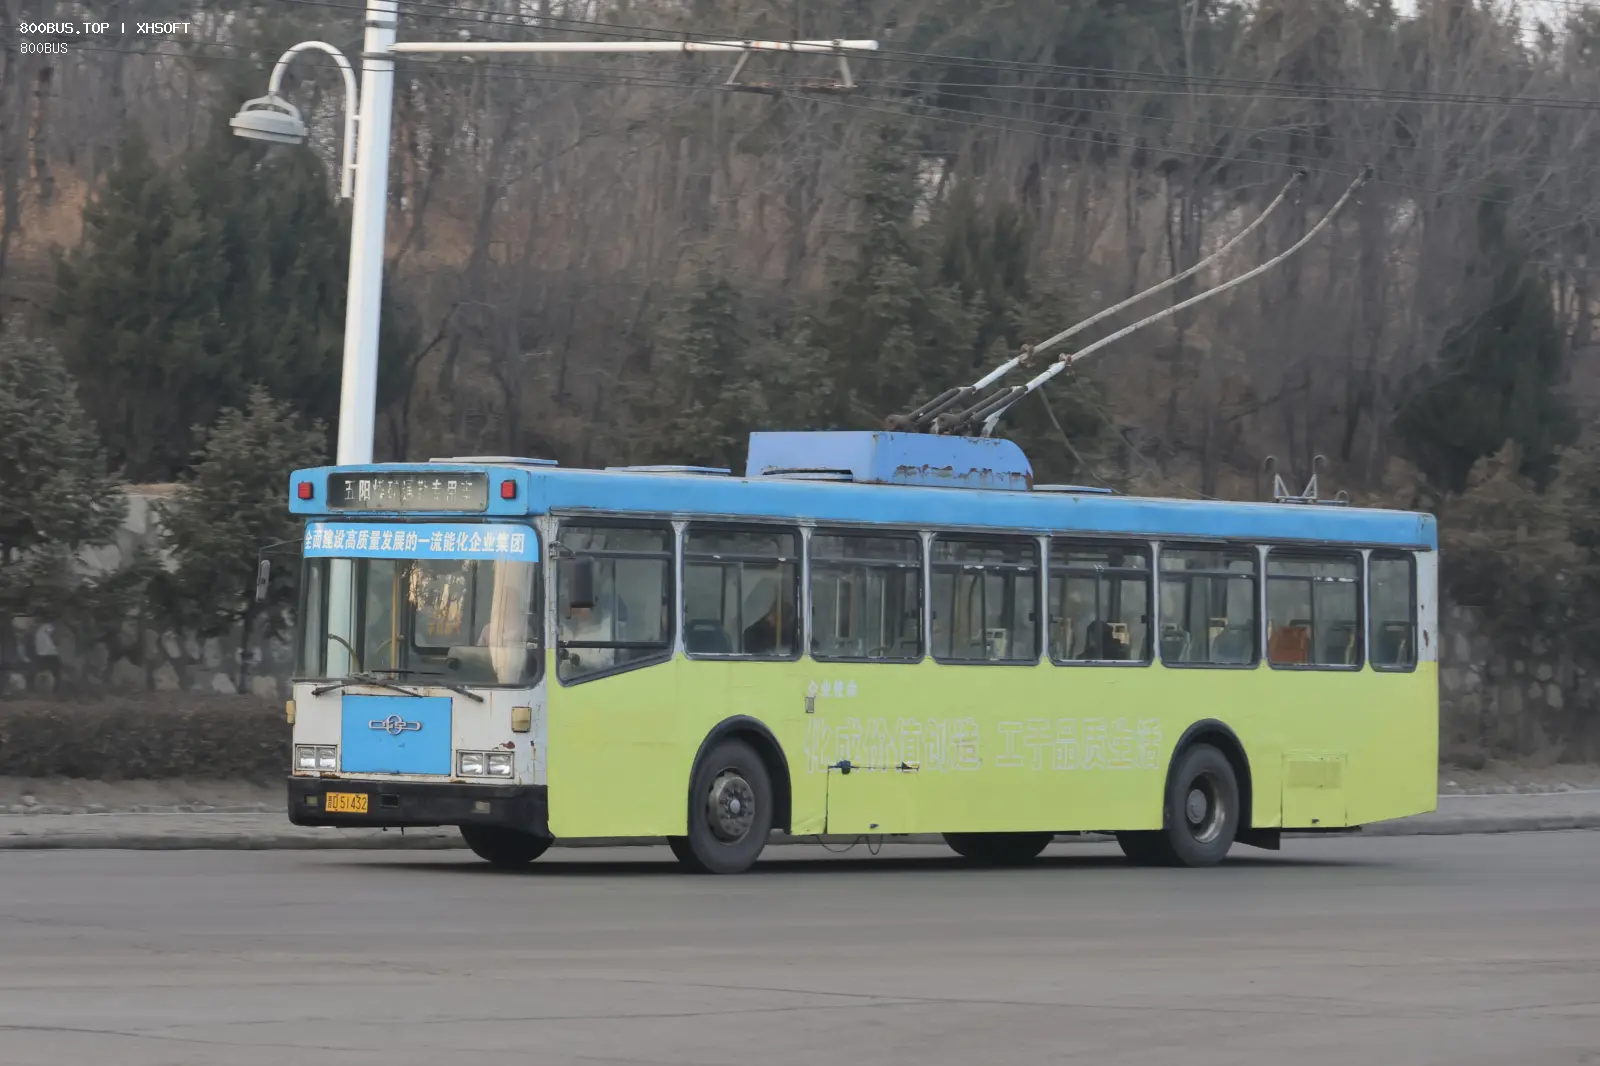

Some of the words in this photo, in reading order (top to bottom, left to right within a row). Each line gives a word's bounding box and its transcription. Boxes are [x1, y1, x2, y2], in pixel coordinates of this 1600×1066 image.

[304, 528, 525, 554] 全面建设高质量发展的一流能化企业集团
